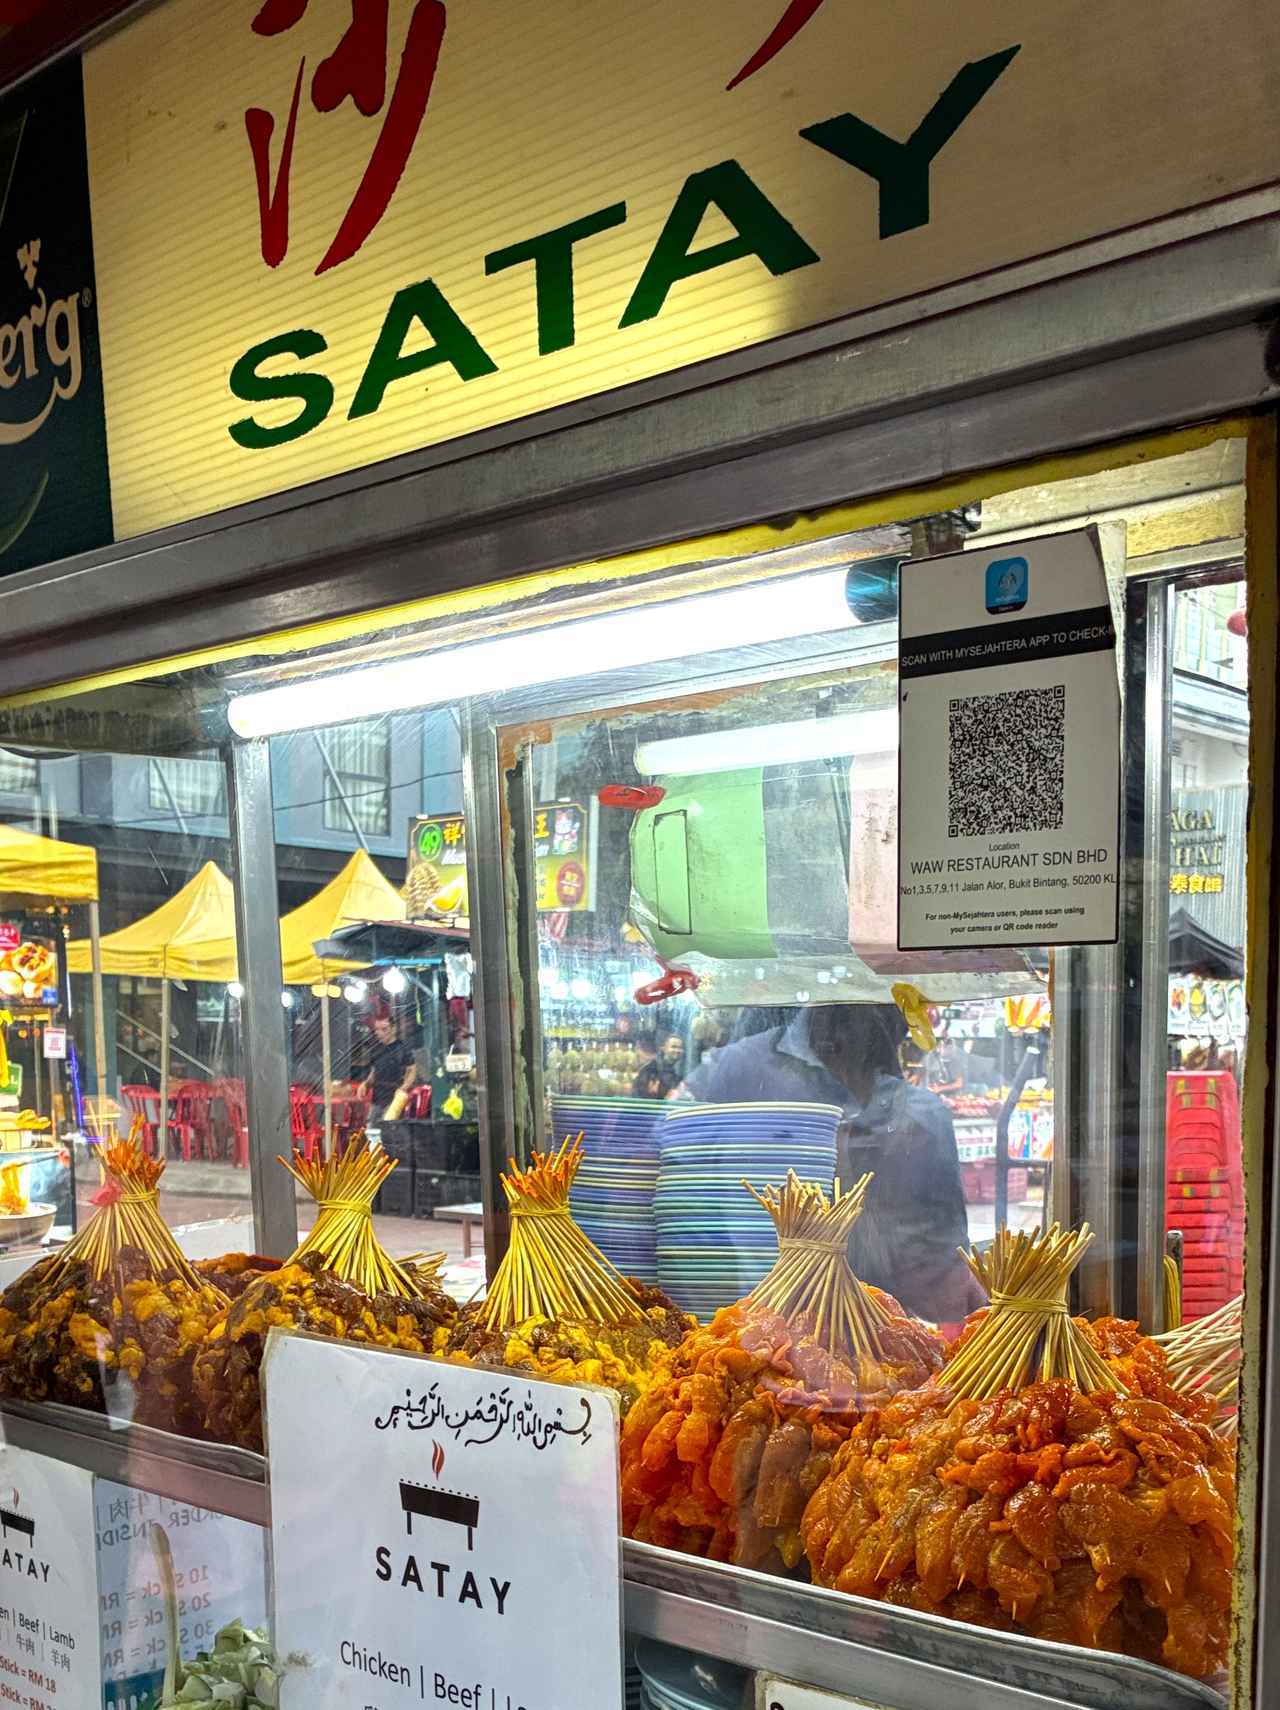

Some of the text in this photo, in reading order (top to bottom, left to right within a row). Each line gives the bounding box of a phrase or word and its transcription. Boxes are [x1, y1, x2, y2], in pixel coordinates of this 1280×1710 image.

[228, 45, 1022, 449] SATAY
[901, 653, 927, 667] SCAN
[928, 649, 953, 662] WITH
[955, 639, 1027, 659] MYSEJAHTERA
[1028, 634, 1050, 648] APP
[1051, 632, 1067, 644] TO
[988, 842, 1020, 852] Location
[910, 848, 1108, 875] WAW RESTAURANT SDN BHD
[961, 881, 985, 892] Jalan
[1008, 878, 1031, 889] Bukit
[1072, 874, 1101, 886] 50200
[1103, 873, 1117, 884] KL
[925, 912, 937, 920] For
[996, 910, 1018, 918] users,
[1019, 908, 1043, 918] please
[1044, 907, 1062, 916] scan
[1063, 906, 1085, 916] using
[950, 926, 965, 935] your
[1002, 922, 1014, 931] QR
[1015, 921, 1034, 930] code
[1035, 920, 1058, 929] reader
[375, 1545, 511, 1615] SATAY
[19, 1612, 40, 1633] Beef
[49, 1625, 76, 1650] Lamb
[16, 1633, 35, 1656] 牛肉
[51, 1649, 71, 1672] 羊肉
[28, 1668, 43, 1688] RM
[46, 1678, 57, 1694] 18
[340, 1640, 411, 1687] Chicken
[434, 1672, 482, 1710] Beef
[0, 1683, 20, 1705] Stick
